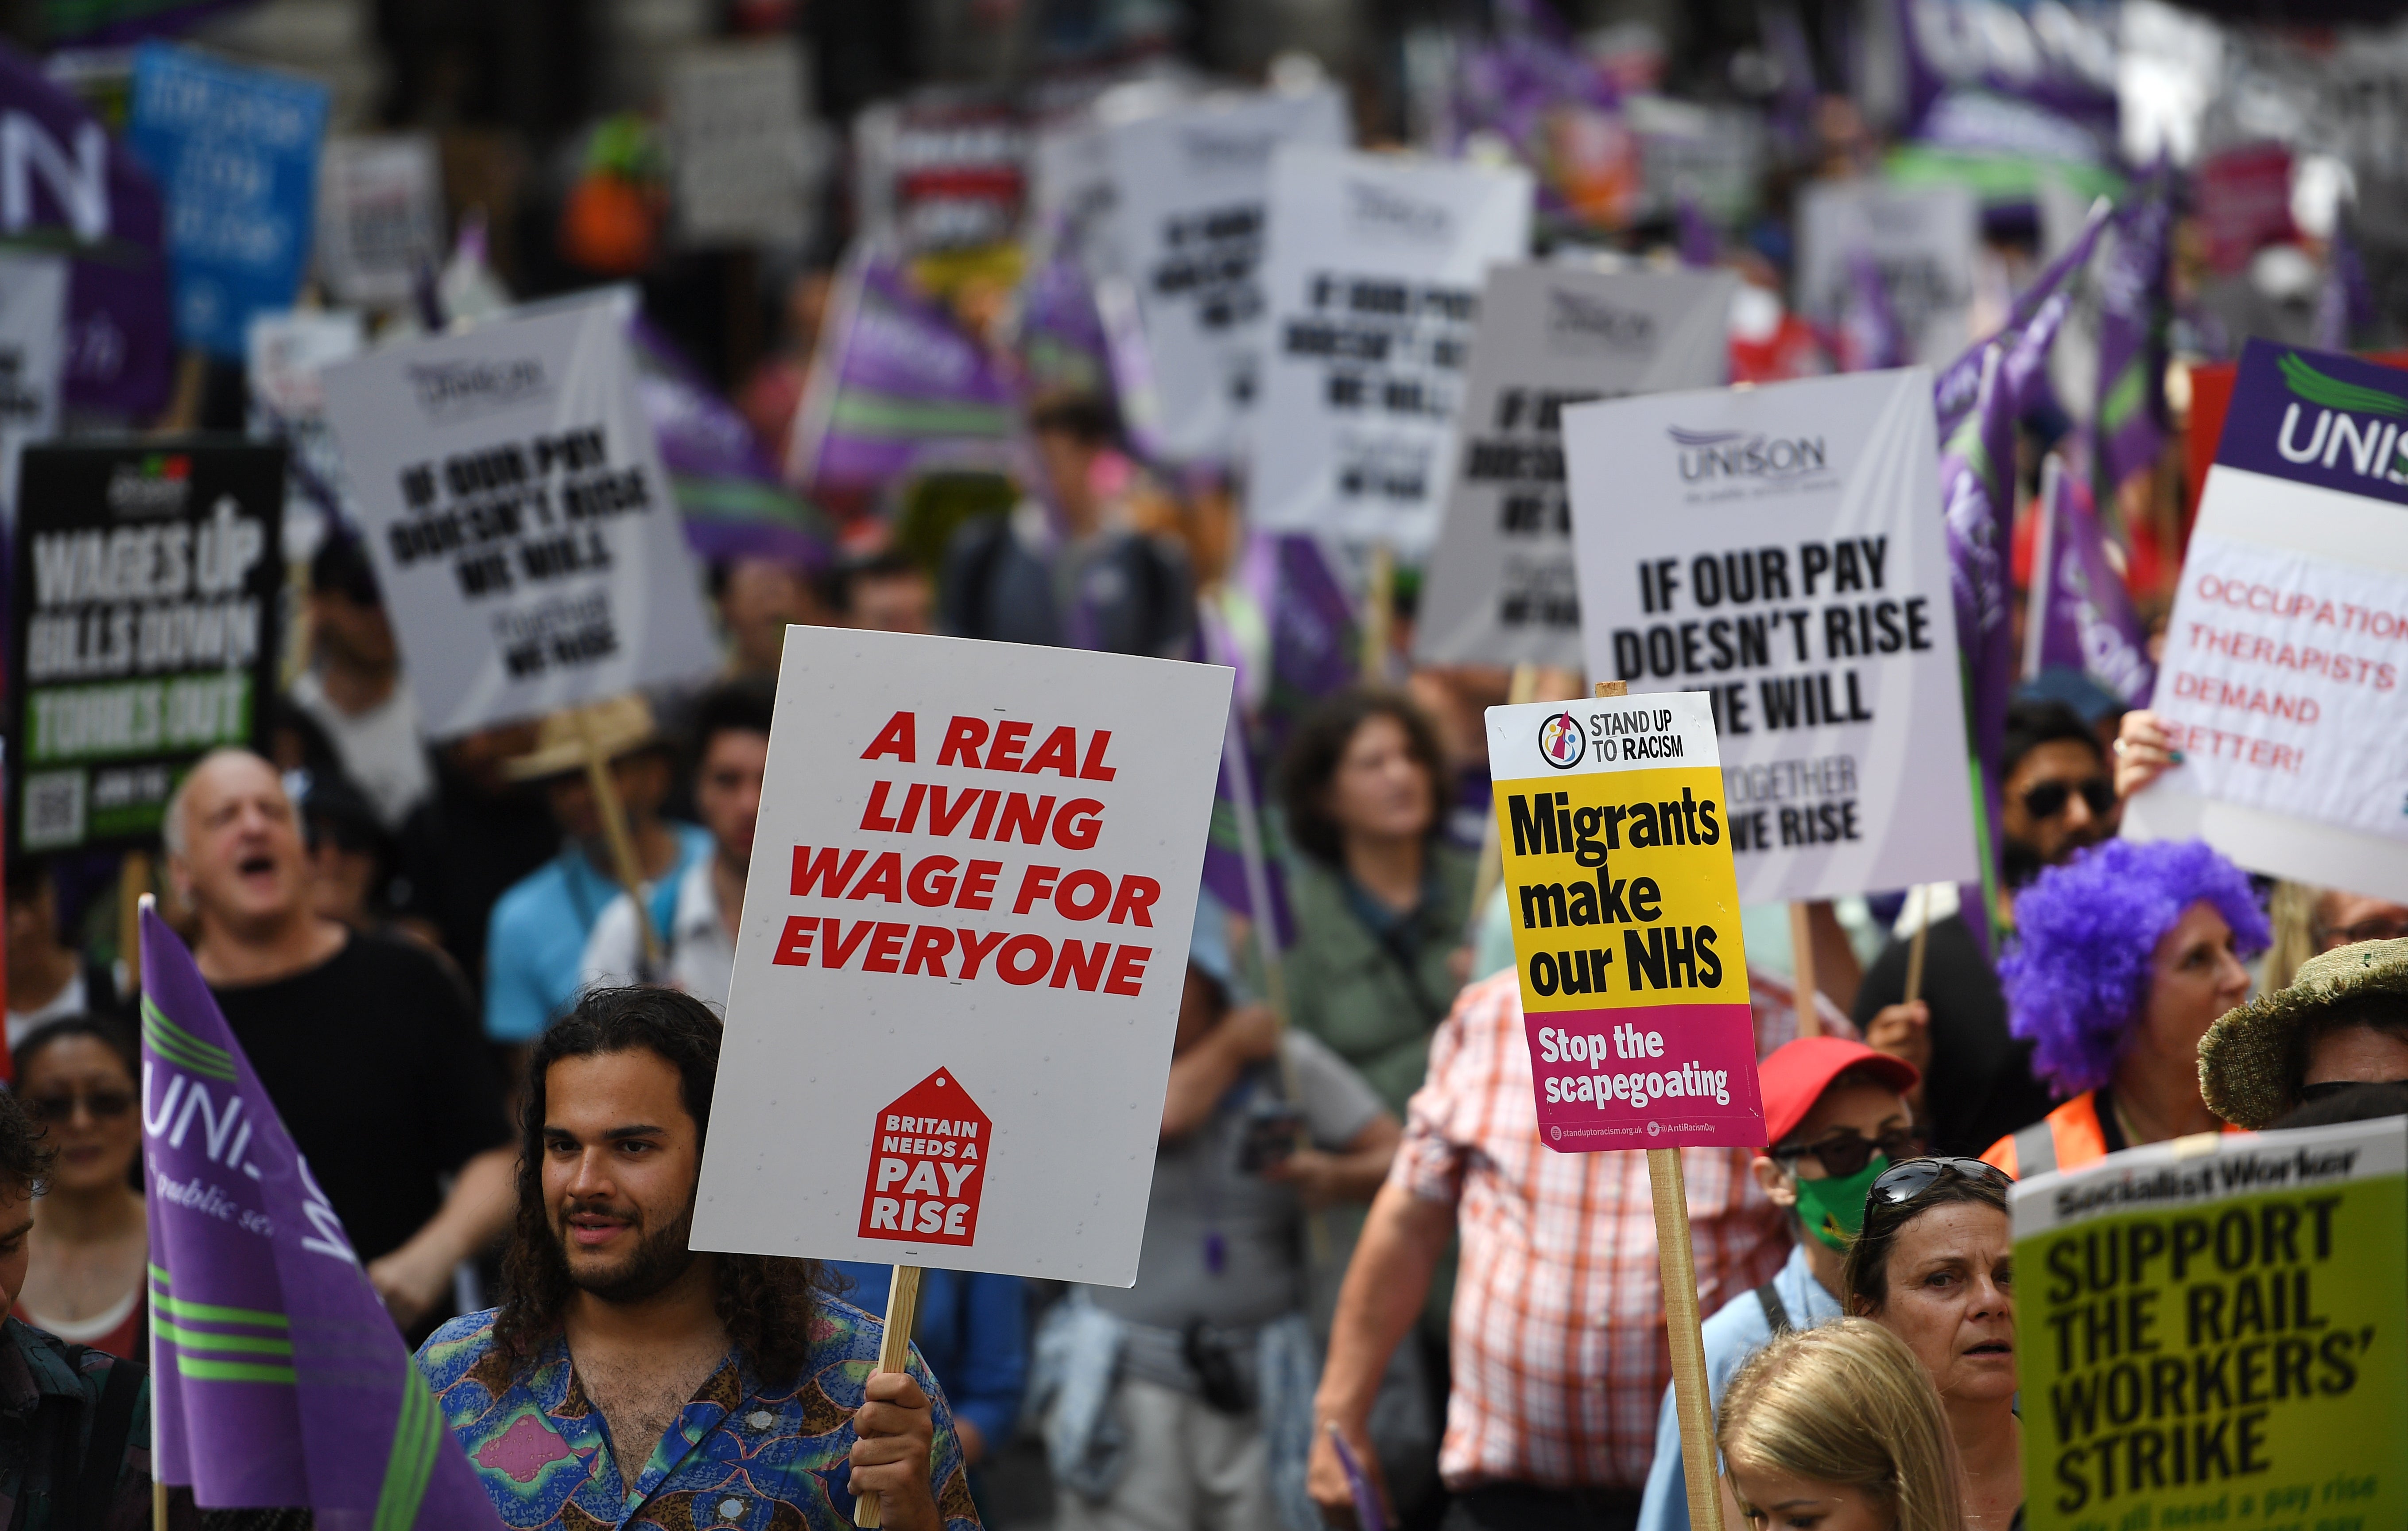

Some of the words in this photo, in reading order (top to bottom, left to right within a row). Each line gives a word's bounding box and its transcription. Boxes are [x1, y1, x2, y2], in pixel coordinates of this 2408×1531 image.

[1679, 434, 1825, 483] UNISON
[1639, 558, 1680, 615] IF
[1691, 546, 1792, 609] OUR
[1800, 535, 1889, 598] PAY
[1613, 609, 1811, 682] DOESN'T
[1824, 597, 1933, 659] RISE
[2188, 622, 2397, 693] THERAPISTS
[1590, 711, 1650, 737] STAND
[1653, 709, 1672, 732] UP
[1760, 669, 1873, 731] WILL
[2173, 670, 2321, 726] DEMAND
[860, 711, 915, 763] A
[936, 715, 1117, 782] REAL
[1592, 739, 1617, 762] TO
[1622, 734, 1684, 761] RACISM
[1722, 754, 1857, 804] OGETHER
[859, 780, 1105, 850] LIVING
[1508, 786, 1721, 868] Migrants
[1778, 800, 1862, 847] RISE
[790, 844, 1003, 911] WAGE
[1012, 864, 1161, 928] FOR
[1519, 863, 1662, 929] make
[772, 915, 1153, 997] EVERYONE
[1529, 945, 1614, 997] our
[1623, 925, 1723, 991] NHS
[1538, 1026, 1608, 1070] Stop
[1614, 1022, 1665, 1059] the
[1544, 1059, 1731, 1110] scapegoating
[882, 1135, 957, 1158] NEEDS
[960, 1142, 978, 1160] A
[885, 1115, 978, 1138] BRITAIN
[1563, 1126, 1643, 1138] standuptoracism.org.uk
[1660, 1122, 1716, 1134] @AntiRacismDay
[875, 1157, 977, 1198] PAY
[2055, 1159, 2214, 1216] Socialist
[2219, 1147, 2360, 1190] Worker
[2046, 1195, 2342, 1305] SUPPORT
[2047, 1287, 2163, 1373] THE
[2187, 1269, 2329, 1347] RAIL
[2052, 1322, 2376, 1444] WORKERS'
[2055, 1409, 2272, 1513] STRIKE
